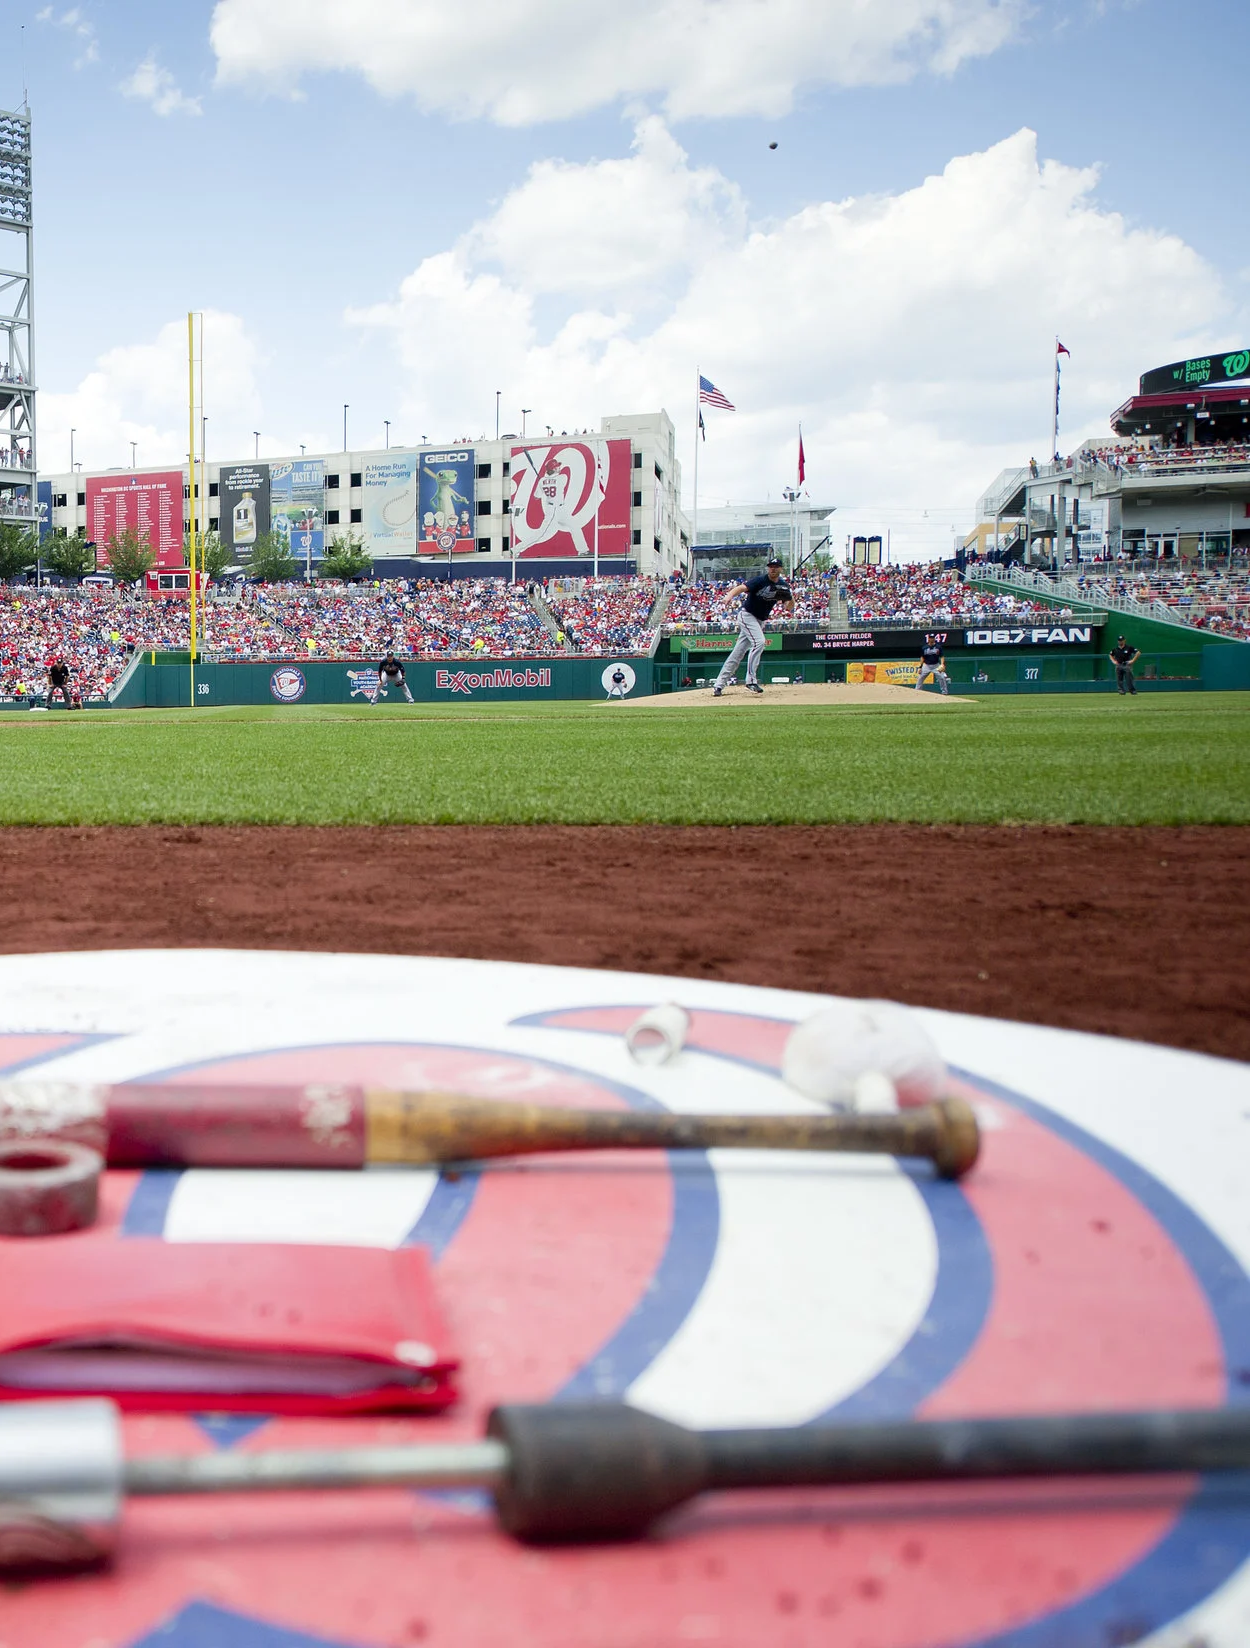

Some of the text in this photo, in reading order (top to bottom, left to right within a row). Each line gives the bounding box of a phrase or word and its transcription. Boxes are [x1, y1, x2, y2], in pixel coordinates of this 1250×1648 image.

[1185, 359, 1210, 372] Bases
[1173, 369, 1183, 380] w/
[1185, 370, 1210, 383] Empty
[425, 452, 469, 464] GEICO
[292, 471, 311, 484] TASTE
[378, 470, 411, 479] Managing
[366, 479, 388, 487] Money
[542, 486, 557, 498] 28
[966, 629, 1025, 645] 106.7
[1031, 627, 1091, 643] FAN
[695, 639, 733, 648] Harris
[275, 667, 301, 677] NATIONALS
[885, 666, 913, 677] TWISTED
[1025, 668, 1039, 680] 377
[436, 668, 551, 694] ExxonMobil
[197, 683, 210, 694] 336
